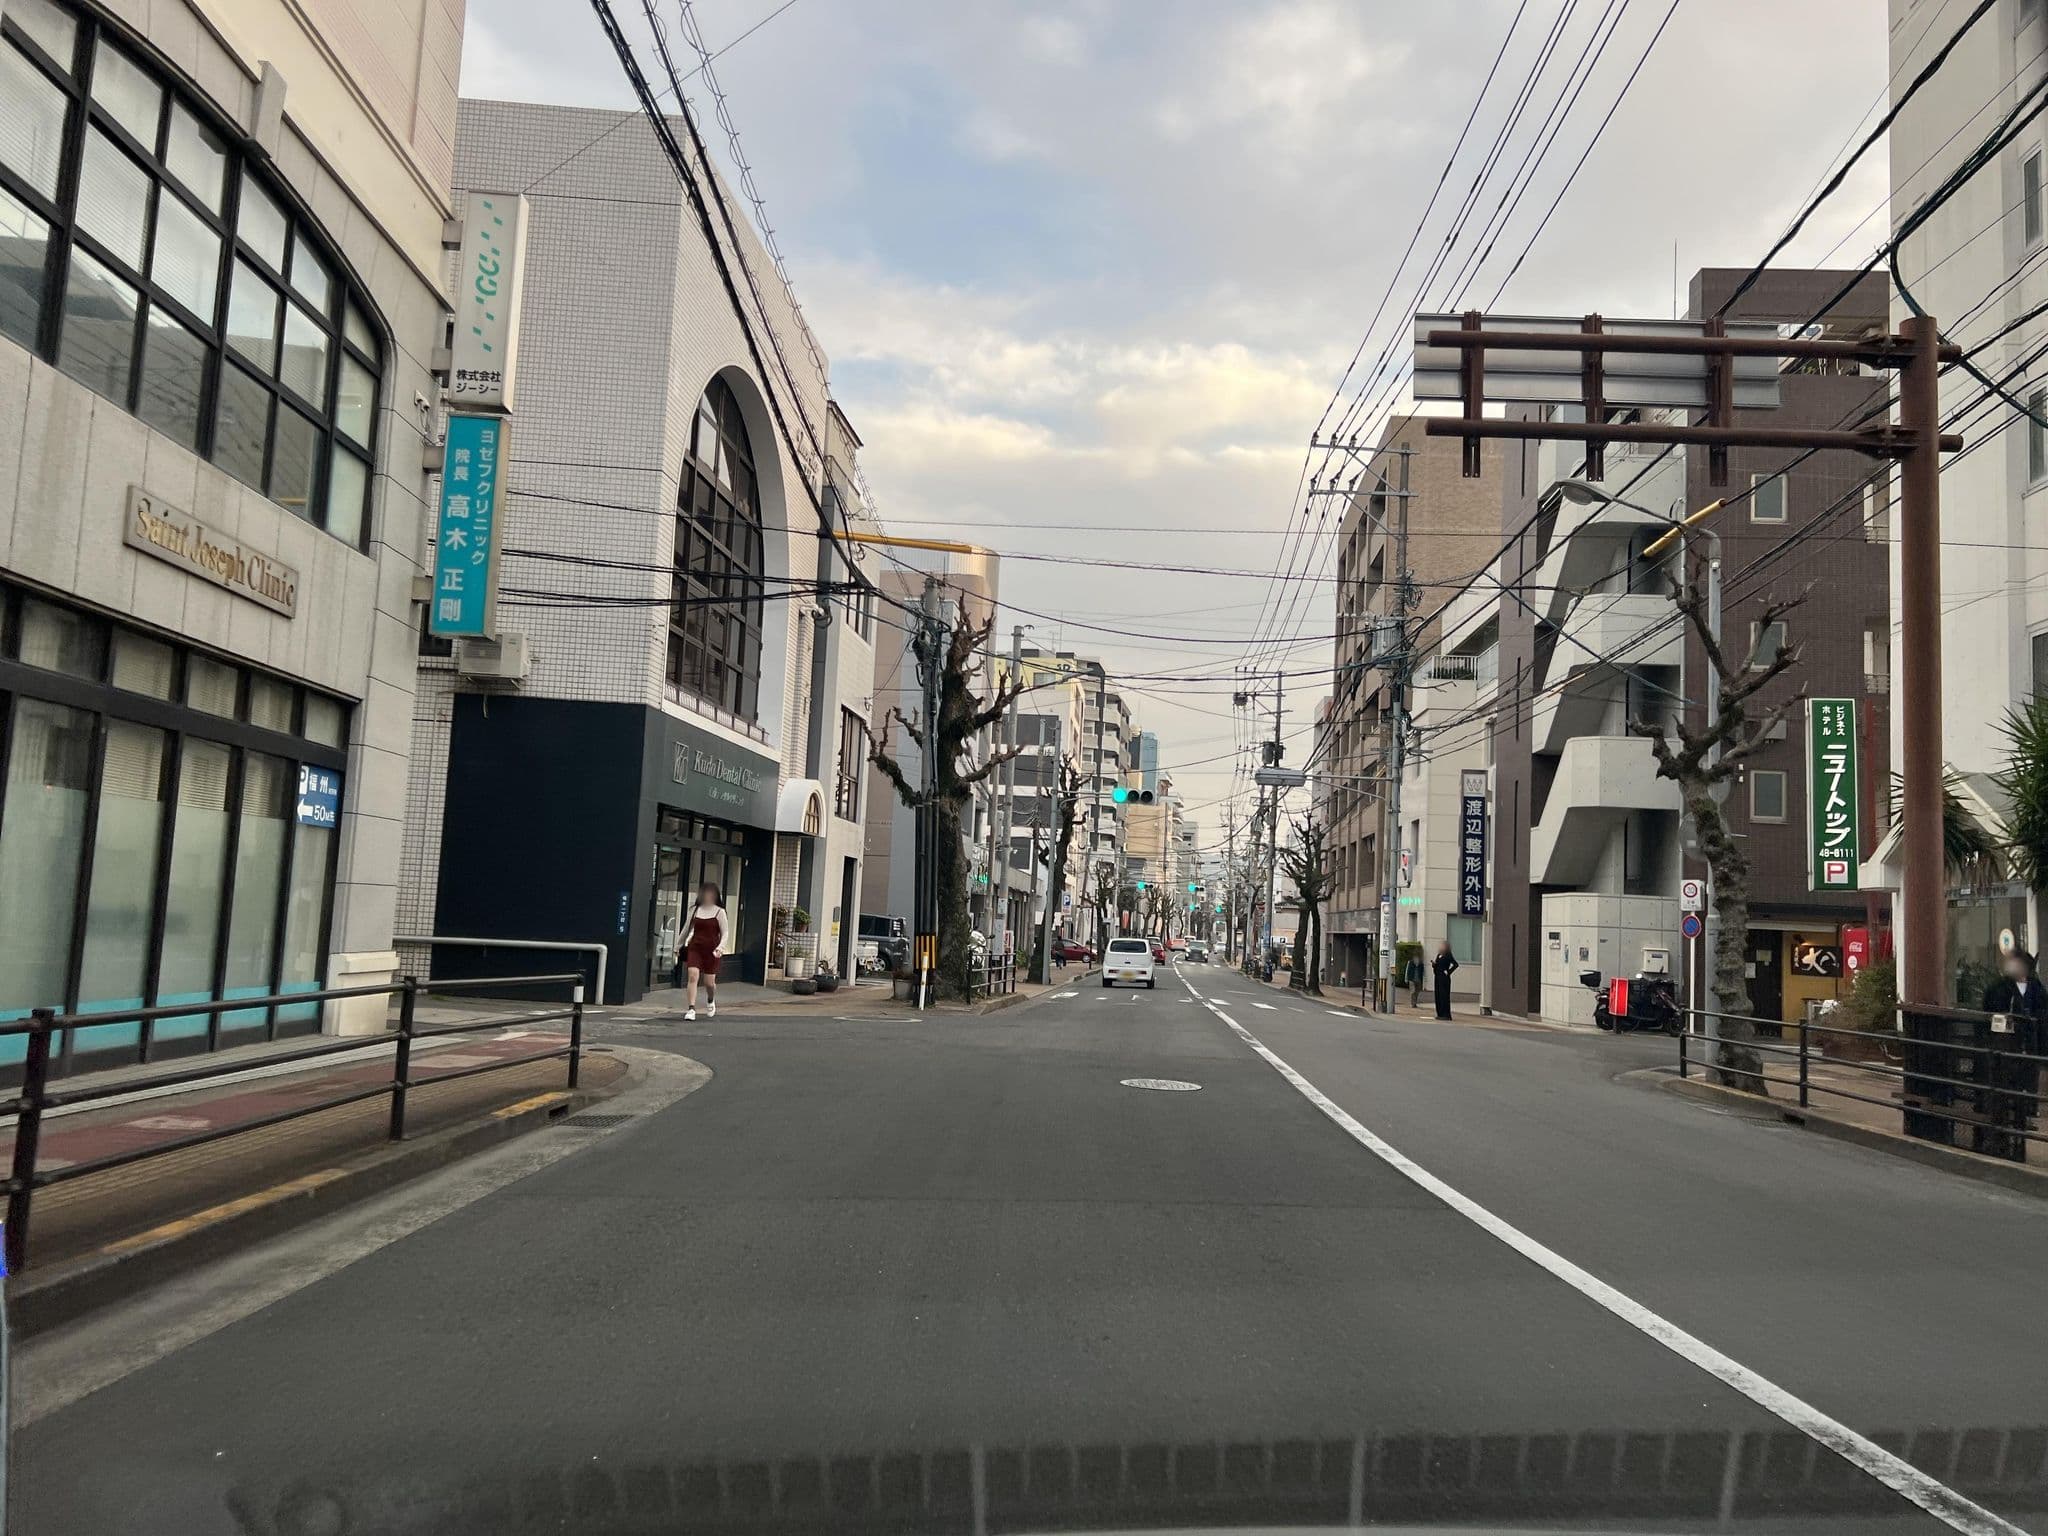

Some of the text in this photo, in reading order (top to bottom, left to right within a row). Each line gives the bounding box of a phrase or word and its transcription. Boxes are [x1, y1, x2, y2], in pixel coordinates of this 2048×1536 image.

[456, 369, 501, 383] 株式会社
[456, 382, 500, 394] ジーシー
[453, 448, 471, 481] 院長
[471, 430, 495, 566] ヨゼフクリニック
[136, 497, 295, 607] Saint Joseph Clinic
[1822, 705, 1832, 736] ホテル
[1836, 705, 1846, 736] ビジネス
[716, 758, 742, 787] Dental
[1821, 744, 1851, 847] ニュートップ
[1464, 799, 1483, 912] 渡辺整形外科
[1826, 862, 1846, 882] P
